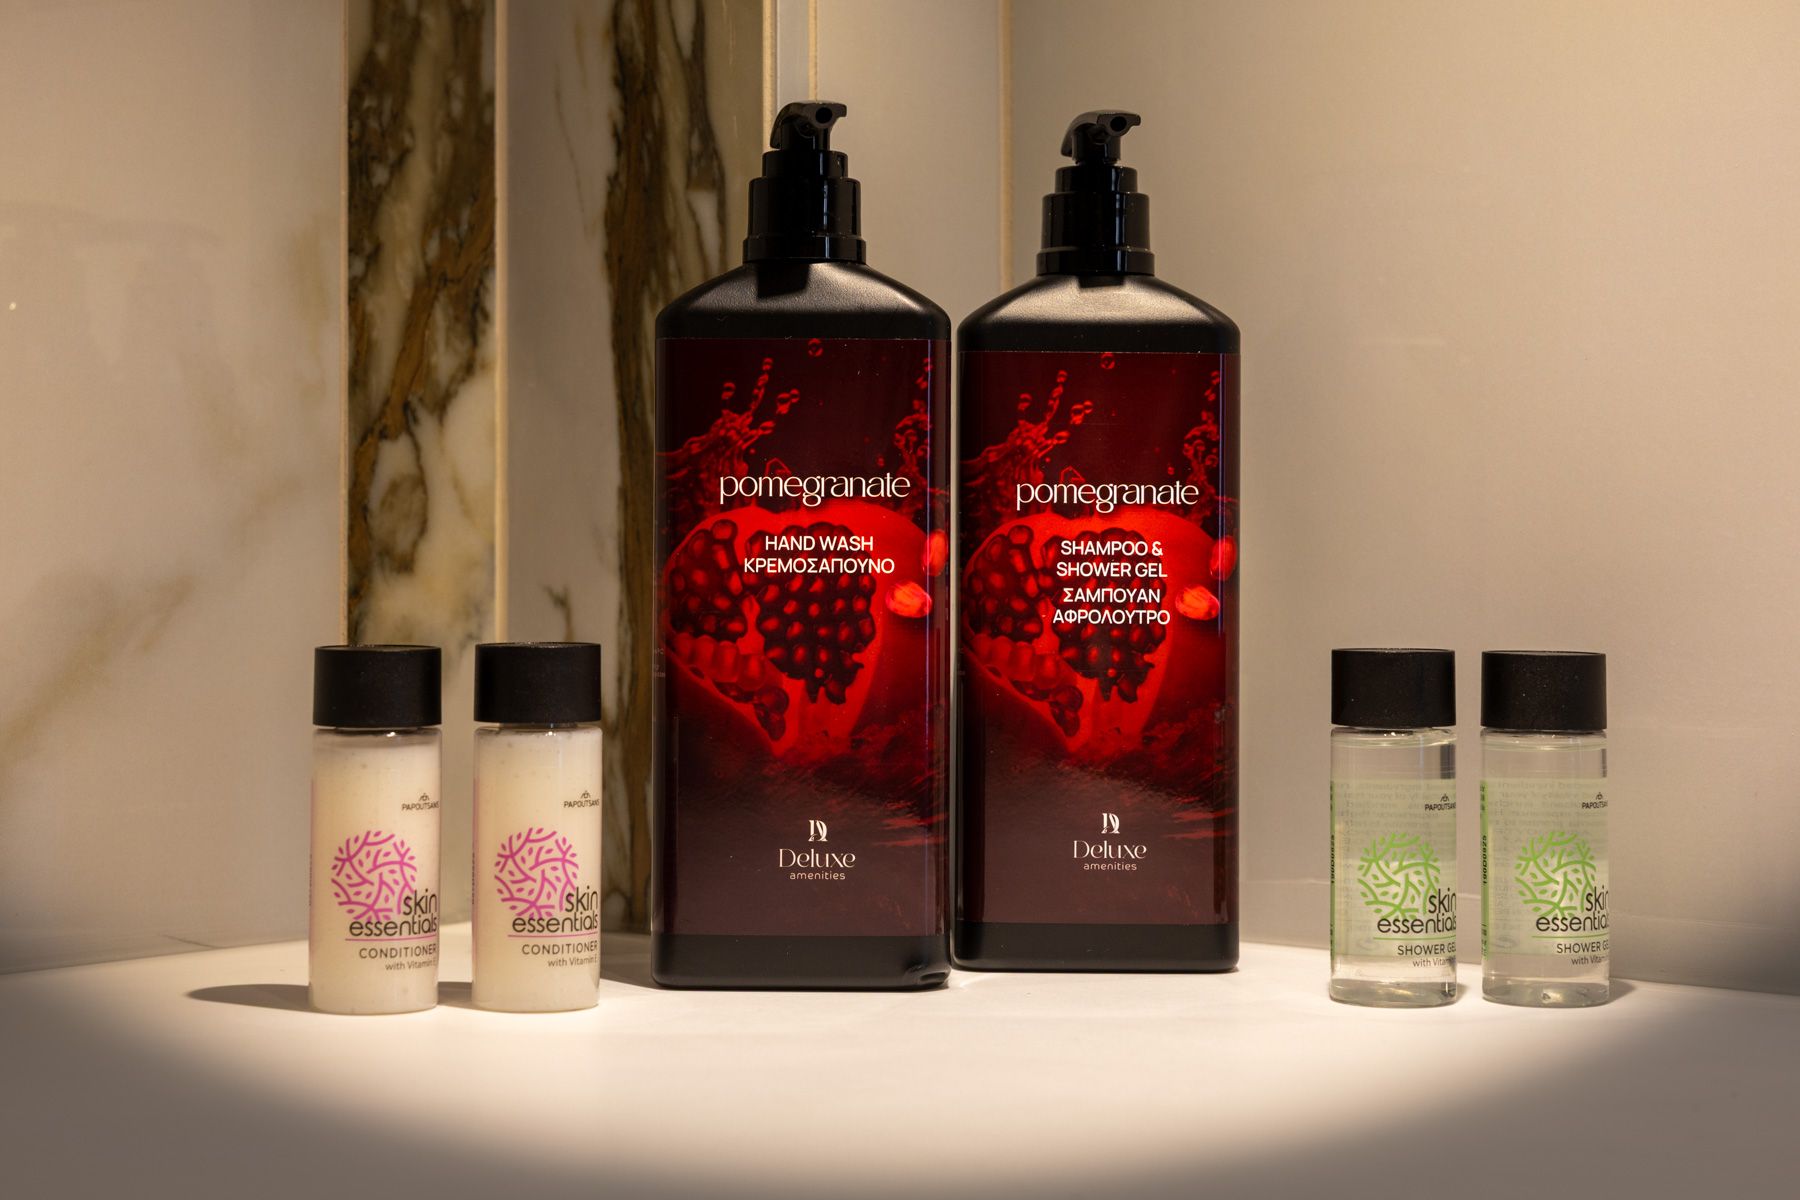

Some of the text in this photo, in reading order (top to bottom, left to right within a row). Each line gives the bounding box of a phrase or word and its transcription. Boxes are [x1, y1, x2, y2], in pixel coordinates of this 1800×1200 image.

[719, 472, 911, 507] pomegranate
[1016, 480, 1200, 513] pomegranate
[765, 535, 874, 551] HAND WASH
[1060, 540, 1163, 556] SHAMPOO &
[743, 557, 895, 574] ΚΡΕΜΟΣΑΠΟΥΝΟ
[1056, 562, 1168, 578] SHOWER GEL
[1063, 587, 1161, 604] ΣΑΜΠΟΥΑΝ
[1052, 609, 1171, 625] ΑΦΡΟΛΟΥΤΡΟ
[1073, 840, 1147, 859] Deluxe
[779, 848, 856, 868] Deluxe
[1083, 861, 1138, 871] amenities
[789, 870, 846, 880] amenities
[403, 888, 437, 916] skin
[565, 885, 598, 913] skin
[1428, 887, 1456, 914] skin
[349, 913, 437, 937] essentials
[512, 910, 598, 933] essentials
[522, 940, 597, 955] CONDITIONER
[1397, 943, 1445, 956] SHOWER
[1556, 941, 1600, 954] SHOWER
[385, 962, 405, 970] with
[548, 959, 567, 967] with
[1413, 958, 1431, 967] with
[1571, 956, 1589, 965] with
